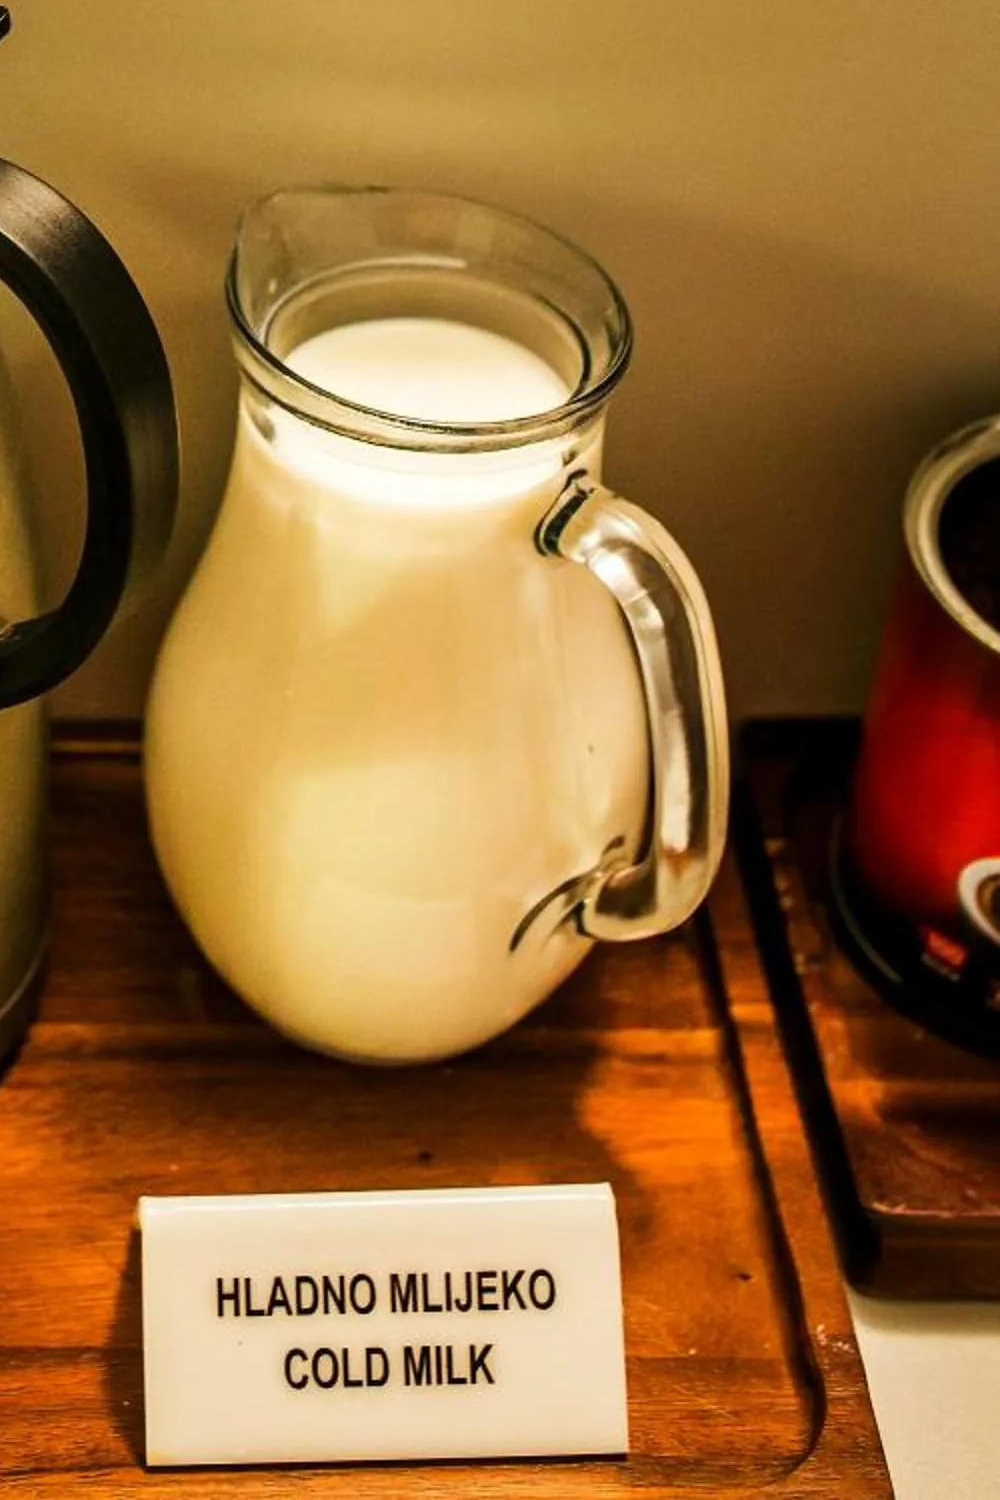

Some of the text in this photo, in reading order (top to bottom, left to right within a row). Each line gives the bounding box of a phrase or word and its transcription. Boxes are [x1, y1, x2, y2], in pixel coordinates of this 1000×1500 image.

[216, 1268, 557, 1318] HLADNO MLIJEKO
[283, 1343, 496, 1391] COLD MILK
